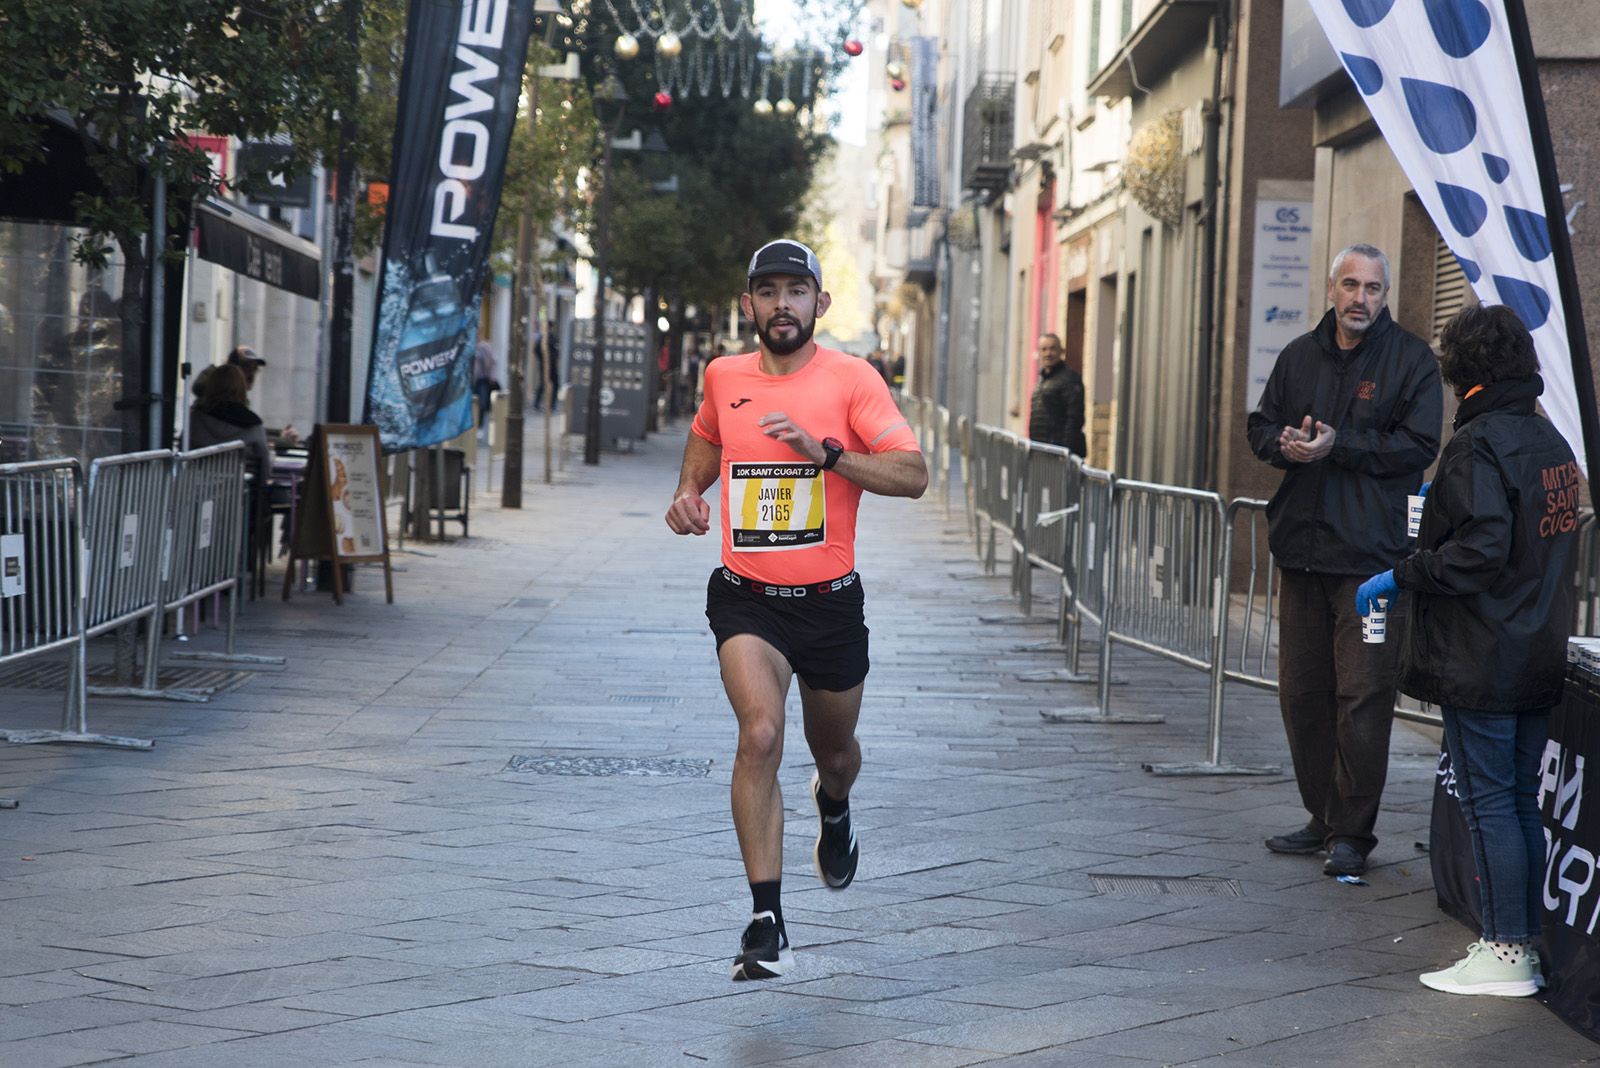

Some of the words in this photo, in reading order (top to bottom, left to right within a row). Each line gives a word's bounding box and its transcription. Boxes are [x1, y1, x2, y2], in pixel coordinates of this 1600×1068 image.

[736, 468, 750, 476] 10K
[750, 468, 773, 476] SANT
[773, 468, 803, 476] CUGAT
[804, 468, 816, 476] 22
[758, 487, 792, 500] JAVIER
[762, 504, 790, 522] 2165
[1539, 510, 1577, 538] CUG
